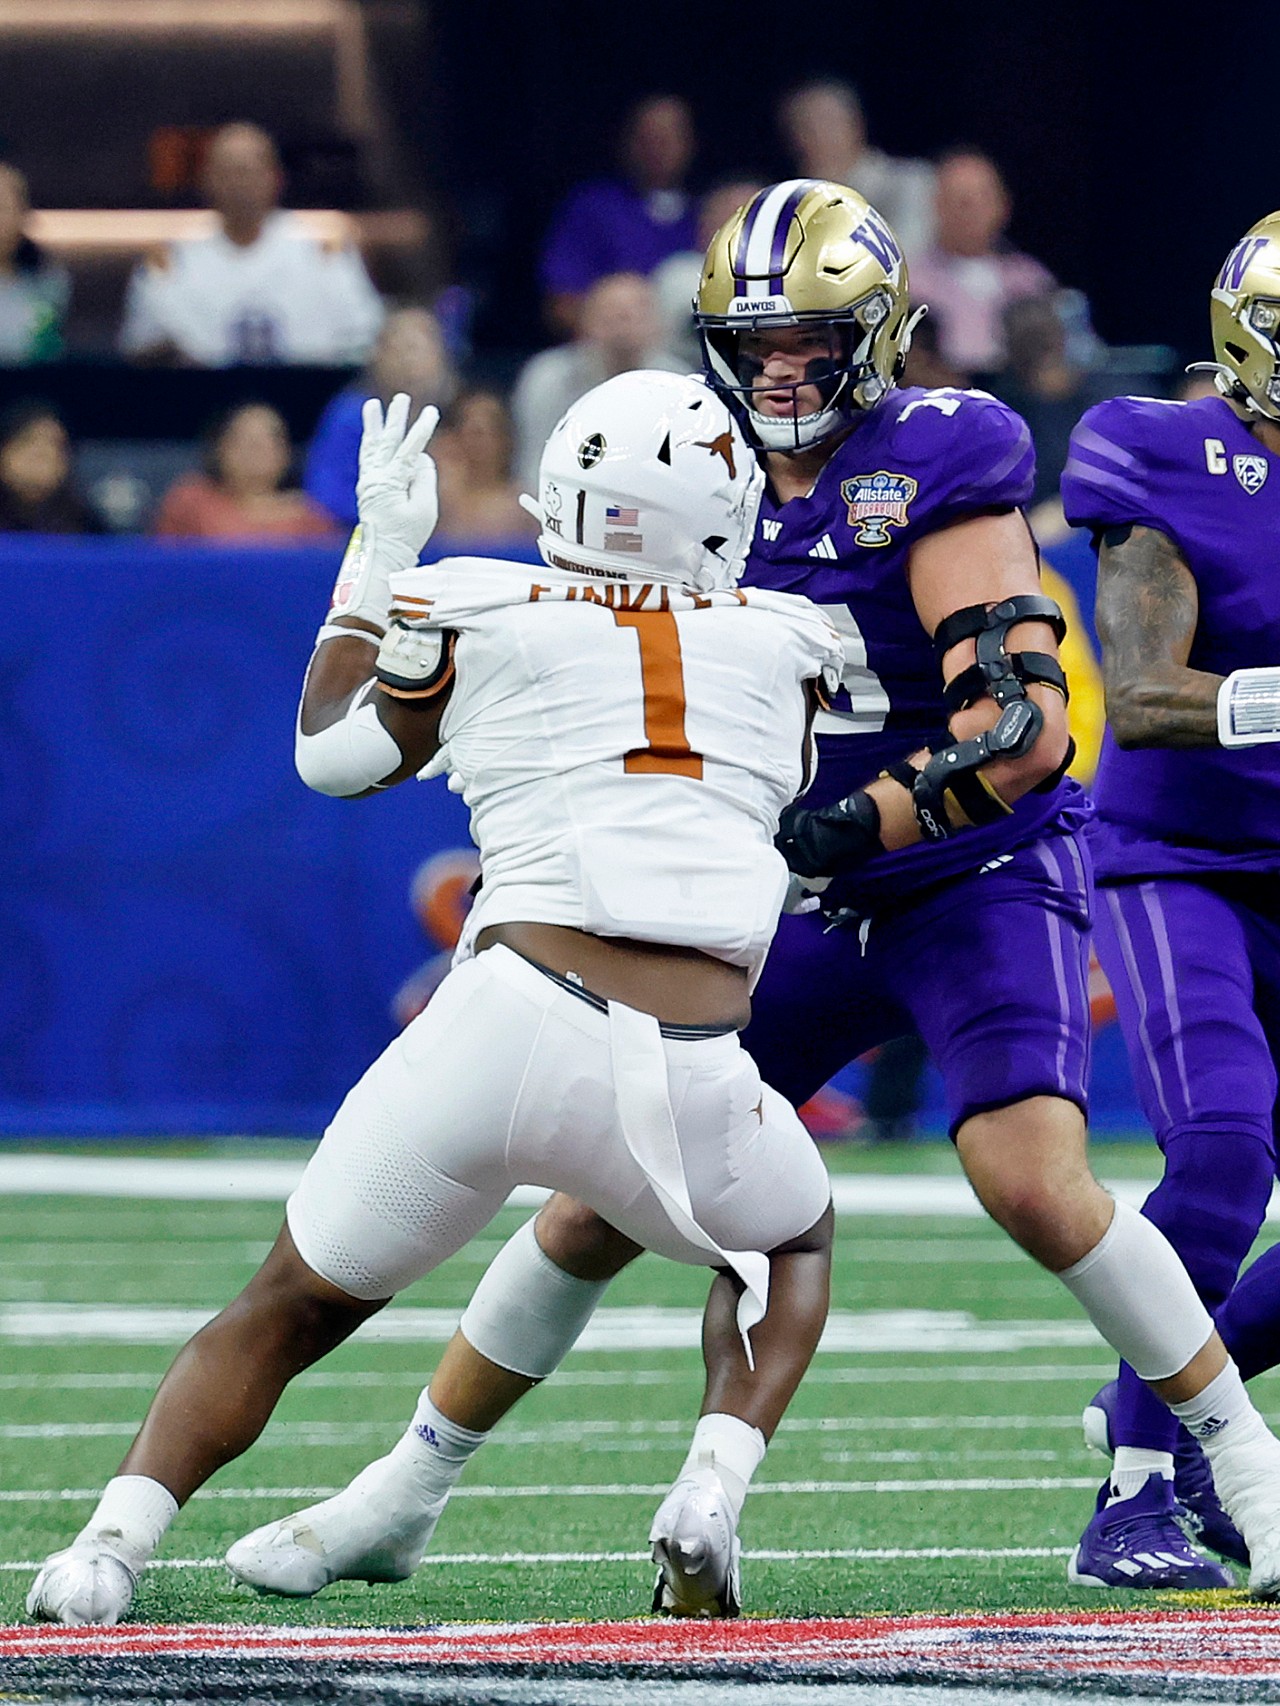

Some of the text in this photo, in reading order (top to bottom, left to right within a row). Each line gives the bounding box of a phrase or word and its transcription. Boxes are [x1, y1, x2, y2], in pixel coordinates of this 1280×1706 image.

[1218, 237, 1270, 291] W
[736, 301, 776, 313] DAWGS
[1204, 438, 1228, 475] C
[1242, 471, 1260, 487] 12
[853, 487, 902, 502] Allstate
[576, 489, 586, 545] 1
[762, 519, 783, 541] W
[611, 609, 704, 781] 1
